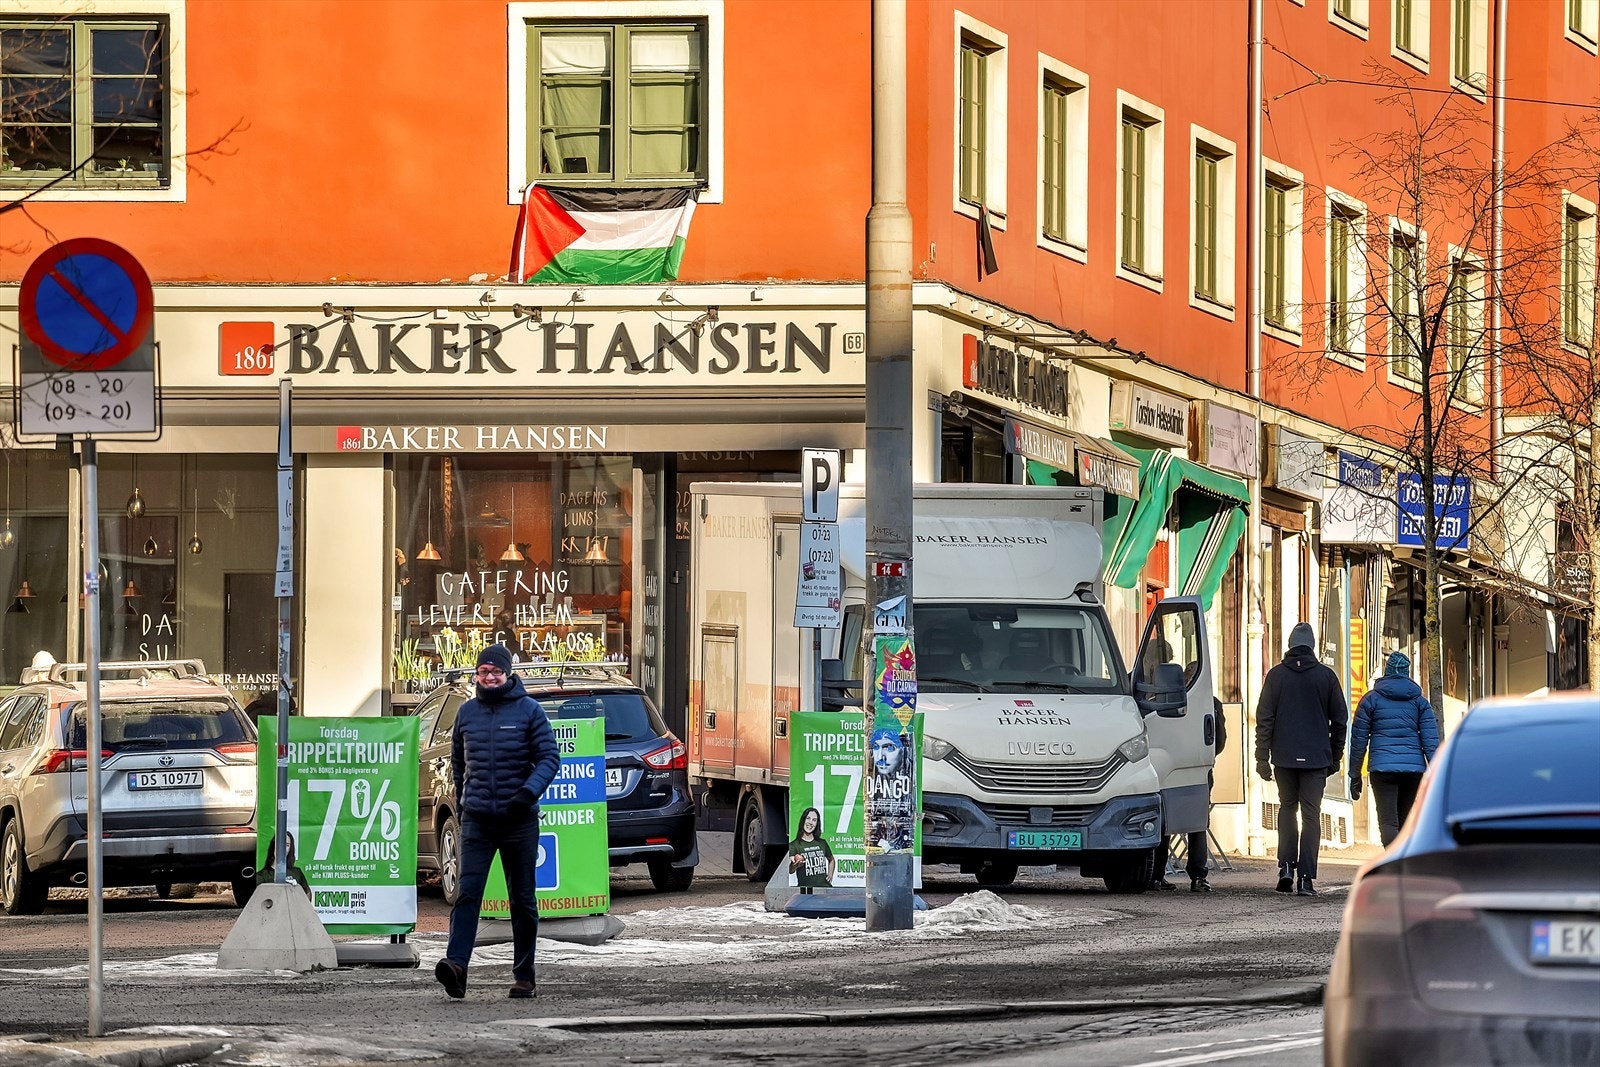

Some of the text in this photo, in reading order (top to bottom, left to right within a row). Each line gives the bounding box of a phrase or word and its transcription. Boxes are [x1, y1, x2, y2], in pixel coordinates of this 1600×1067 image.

[284, 323, 517, 375] BAKER
[536, 321, 838, 375] HANSEN
[847, 335, 862, 350] 68
[52, 379, 76, 394] 08
[101, 378, 123, 393] 20
[45, 402, 76, 422] (09
[101, 401, 131, 420] 20)
[342, 426, 609, 450] 1861 BAKER HANSEN
[811, 457, 832, 514] P
[1400, 480, 1466, 506] TORHOV
[560, 491, 608, 506] DAGENS
[1400, 512, 1462, 538] RENERI
[812, 528, 831, 541] 07-23
[915, 535, 1048, 545] BAKER HANSEN
[561, 536, 581, 553] KR
[808, 547, 834, 564] (07-23)
[418, 603, 501, 626] LEVERT
[236, 673, 279, 684] HANSE
[839, 720, 865, 731] Torsd
[997, 717, 1072, 726] HANSEN
[319, 726, 359, 740] Torsdag
[557, 738, 576, 753] ris
[803, 733, 865, 752] TRIPPEL
[1008, 741, 1077, 756] IVECO
[275, 742, 405, 764] RIPPELTRUMF
[141, 772, 198, 786] DS 10977
[554, 763, 595, 780] ERING
[804, 764, 864, 834] 17
[1019, 834, 1079, 846] BU 35792
[350, 841, 400, 861] BONUS
[837, 859, 865, 873] KIWI
[314, 891, 367, 907] KIWI mini
[350, 900, 366, 909] pris
[1561, 927, 1595, 954] EK
